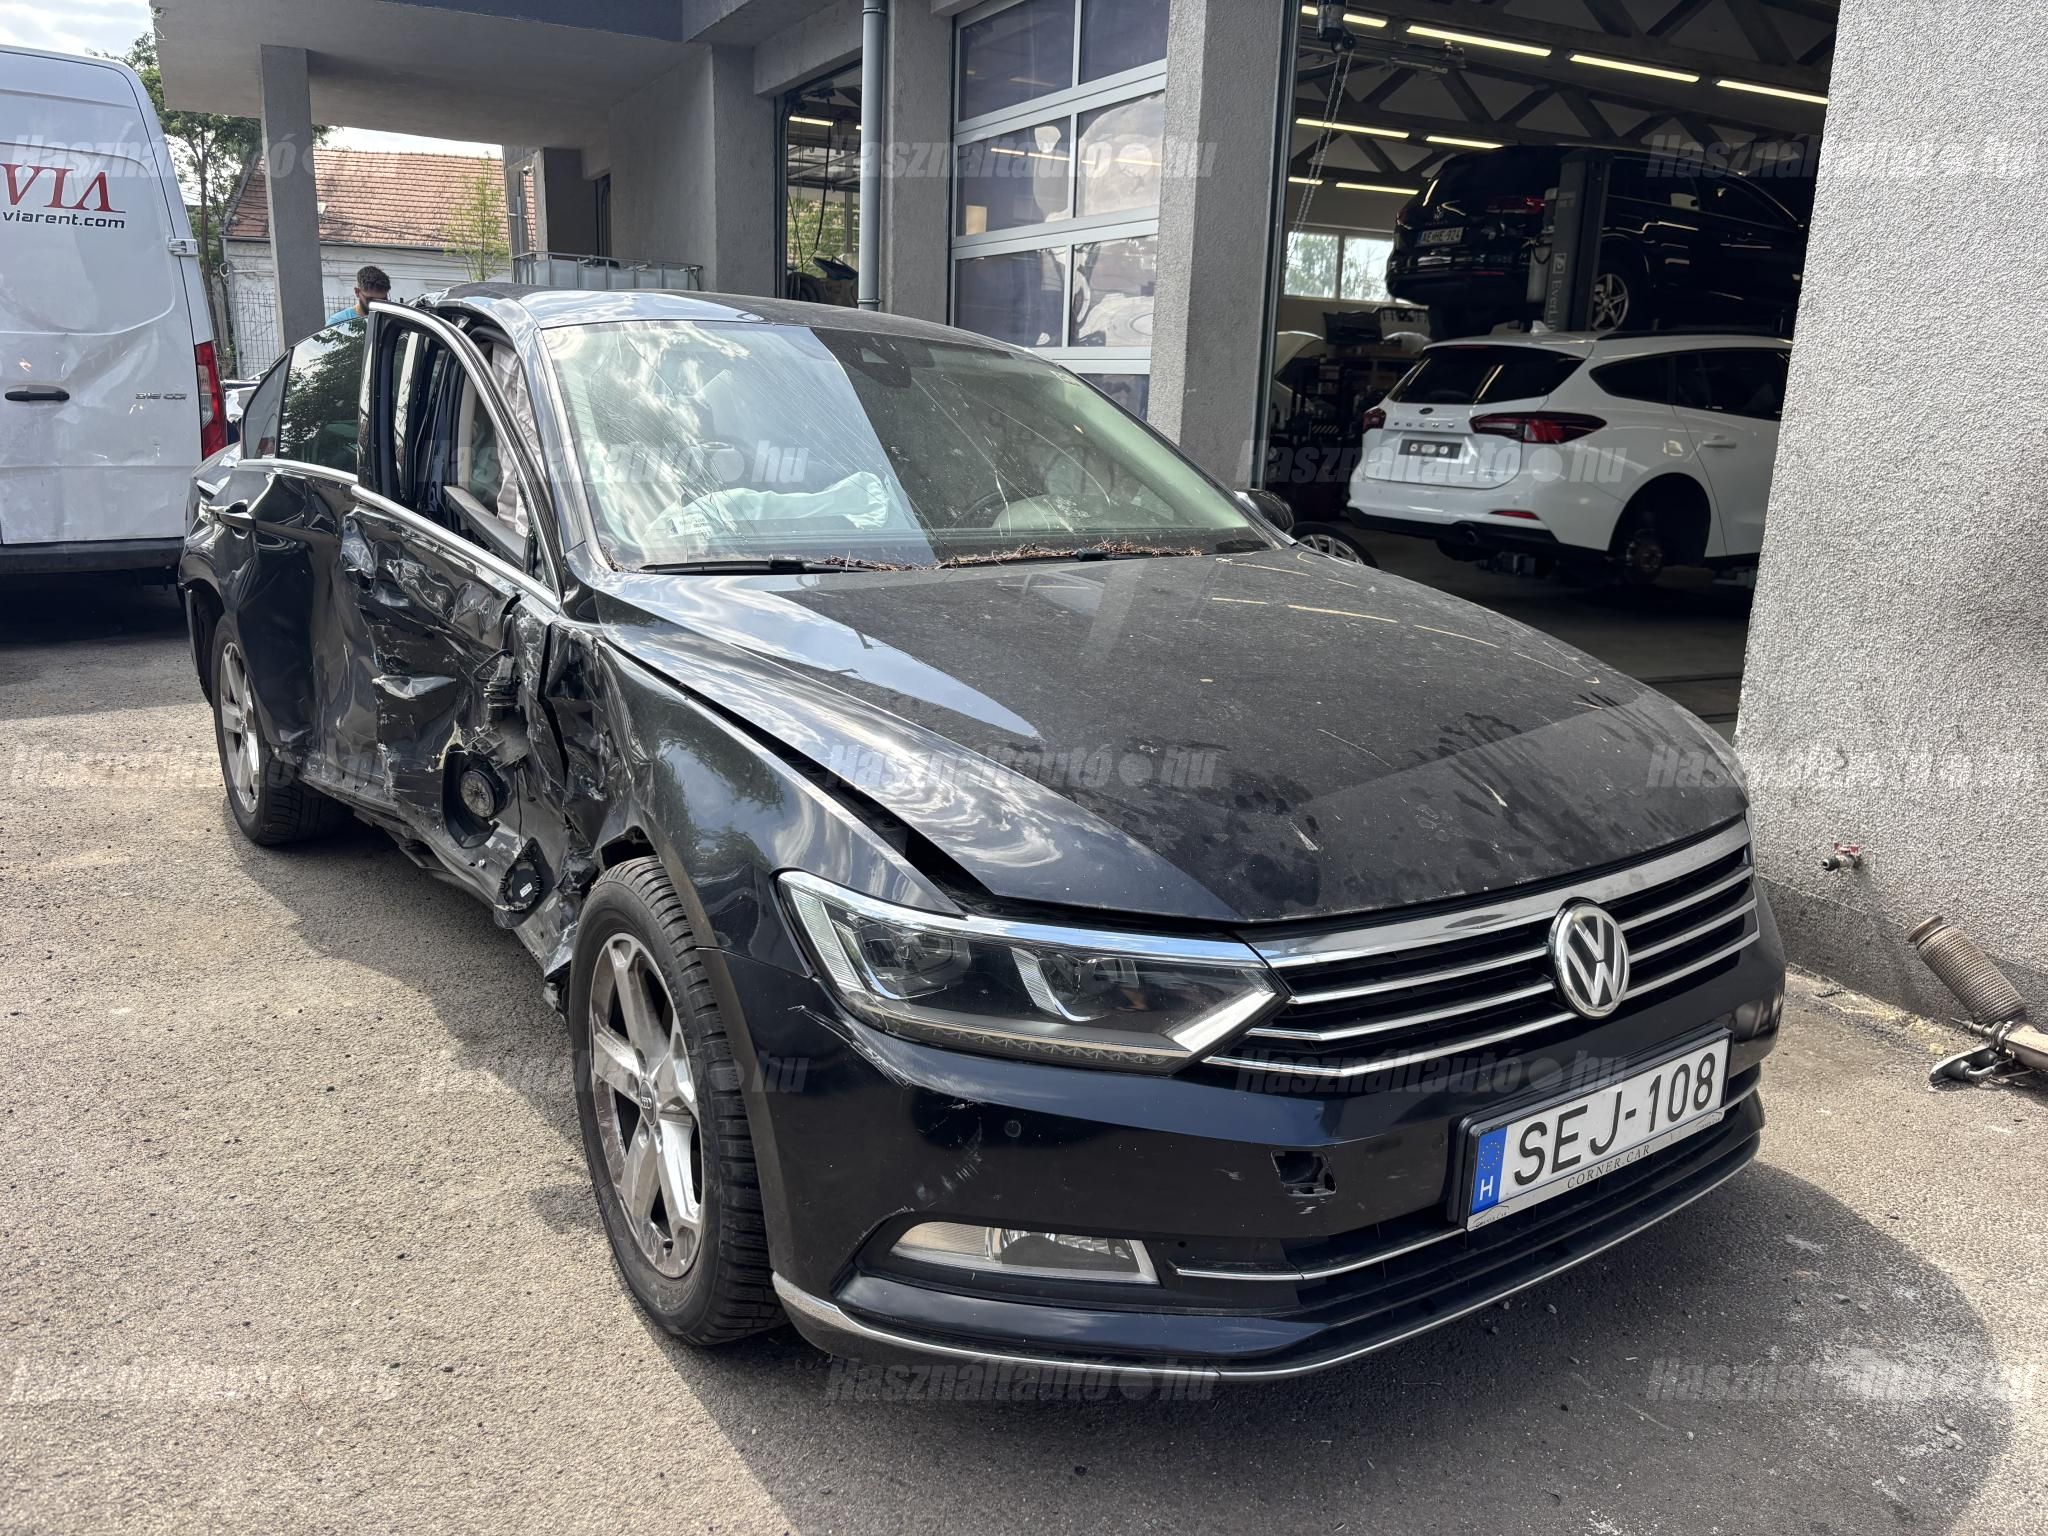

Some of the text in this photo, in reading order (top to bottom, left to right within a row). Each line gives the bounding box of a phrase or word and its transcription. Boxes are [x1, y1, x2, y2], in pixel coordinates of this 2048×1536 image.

[0, 163, 126, 213] VIA
[3, 210, 125, 229] viarent.com
[1514, 1052, 1716, 1186] SEJ-108
[1479, 1175, 1494, 1201] H
